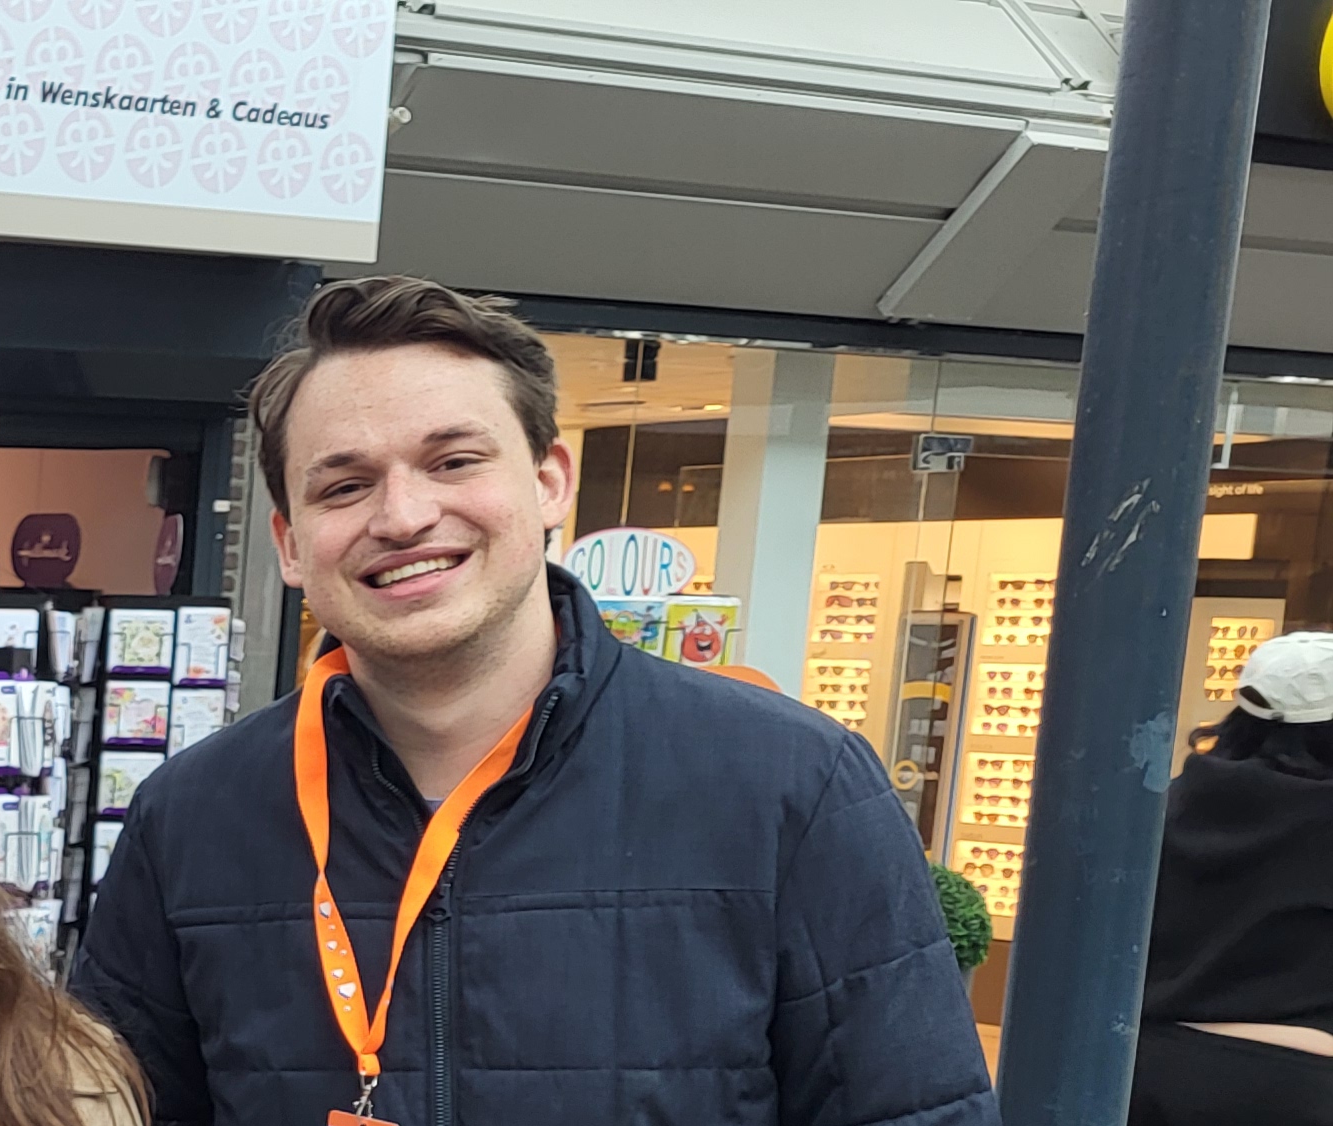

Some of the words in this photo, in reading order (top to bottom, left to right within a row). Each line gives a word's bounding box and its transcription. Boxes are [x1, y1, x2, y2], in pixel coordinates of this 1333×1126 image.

[5, 76, 29, 101] in
[41, 79, 197, 117] Wenskaarten
[206, 97, 224, 119] &
[232, 100, 332, 129] Cadeaus
[571, 533, 688, 596] COLOURS
